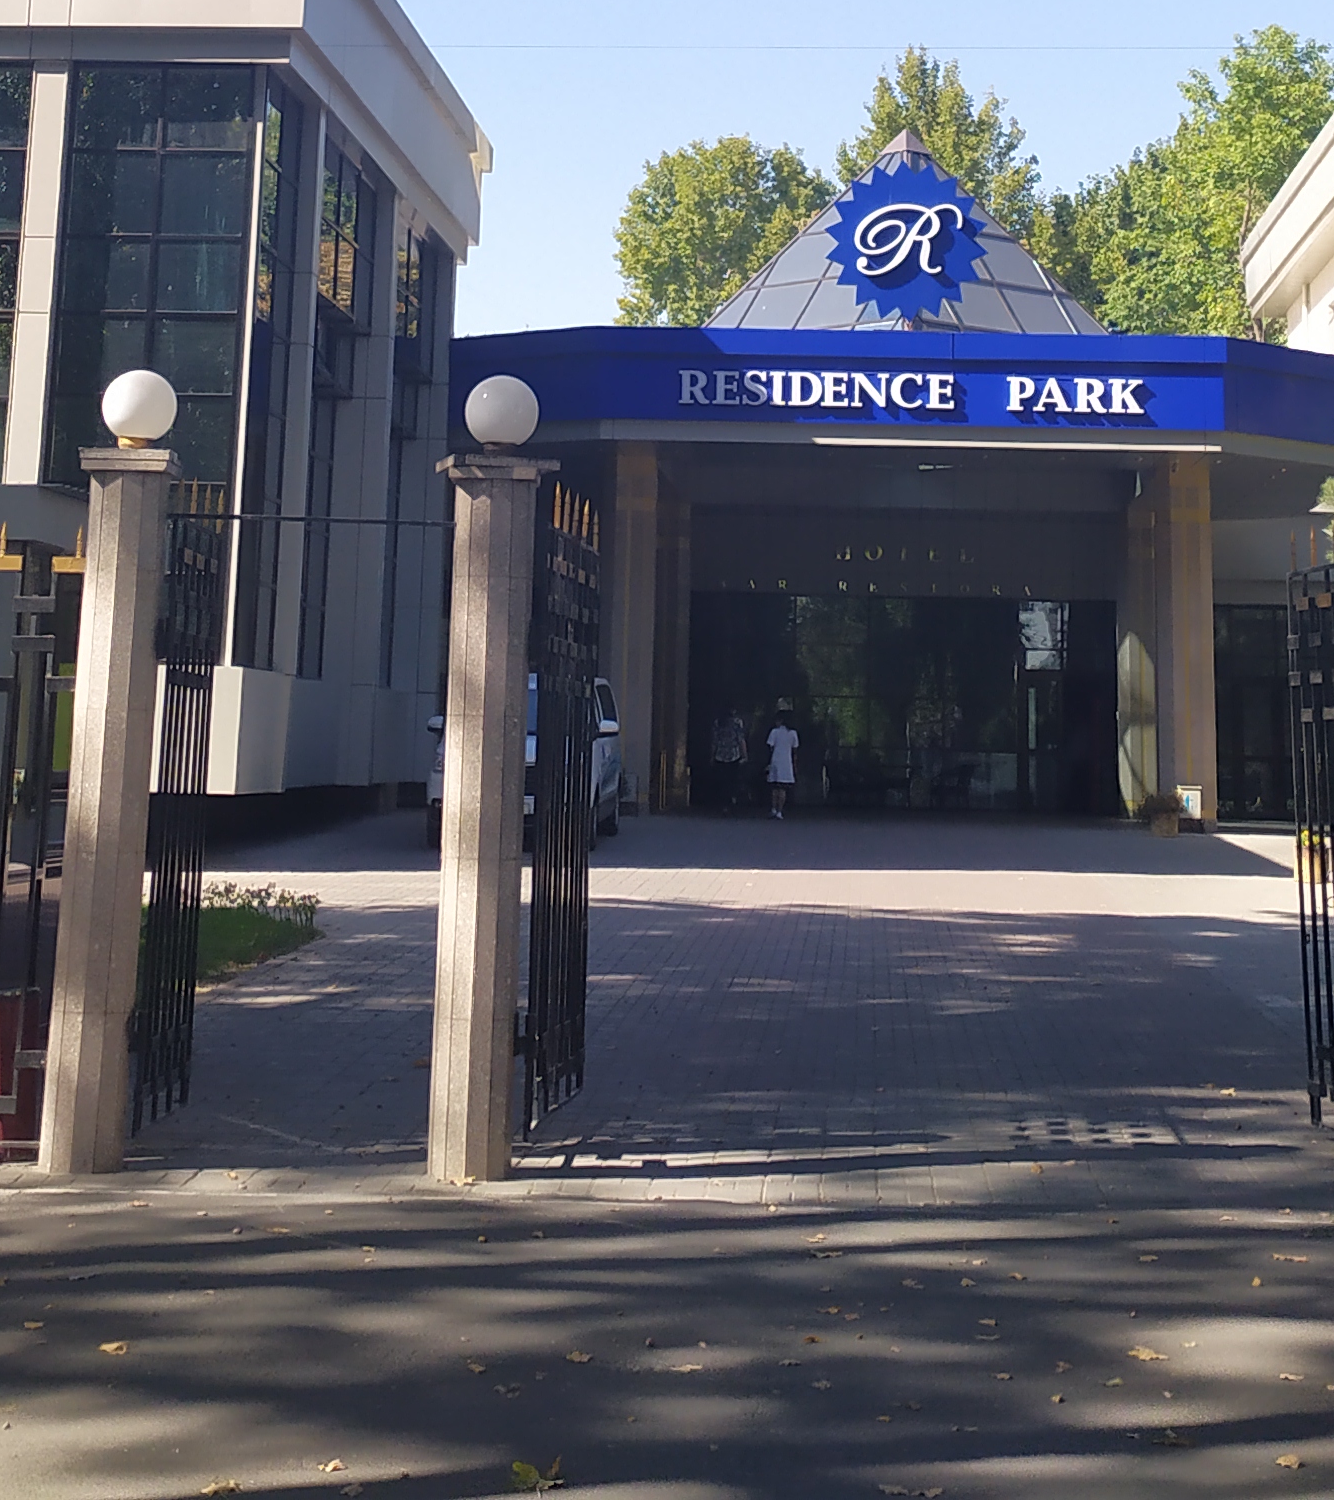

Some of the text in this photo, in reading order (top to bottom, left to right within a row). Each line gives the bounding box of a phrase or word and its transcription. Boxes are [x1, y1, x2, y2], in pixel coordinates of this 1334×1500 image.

[853, 202, 964, 276] R
[677, 368, 1145, 415] RESIDENCE PARK
